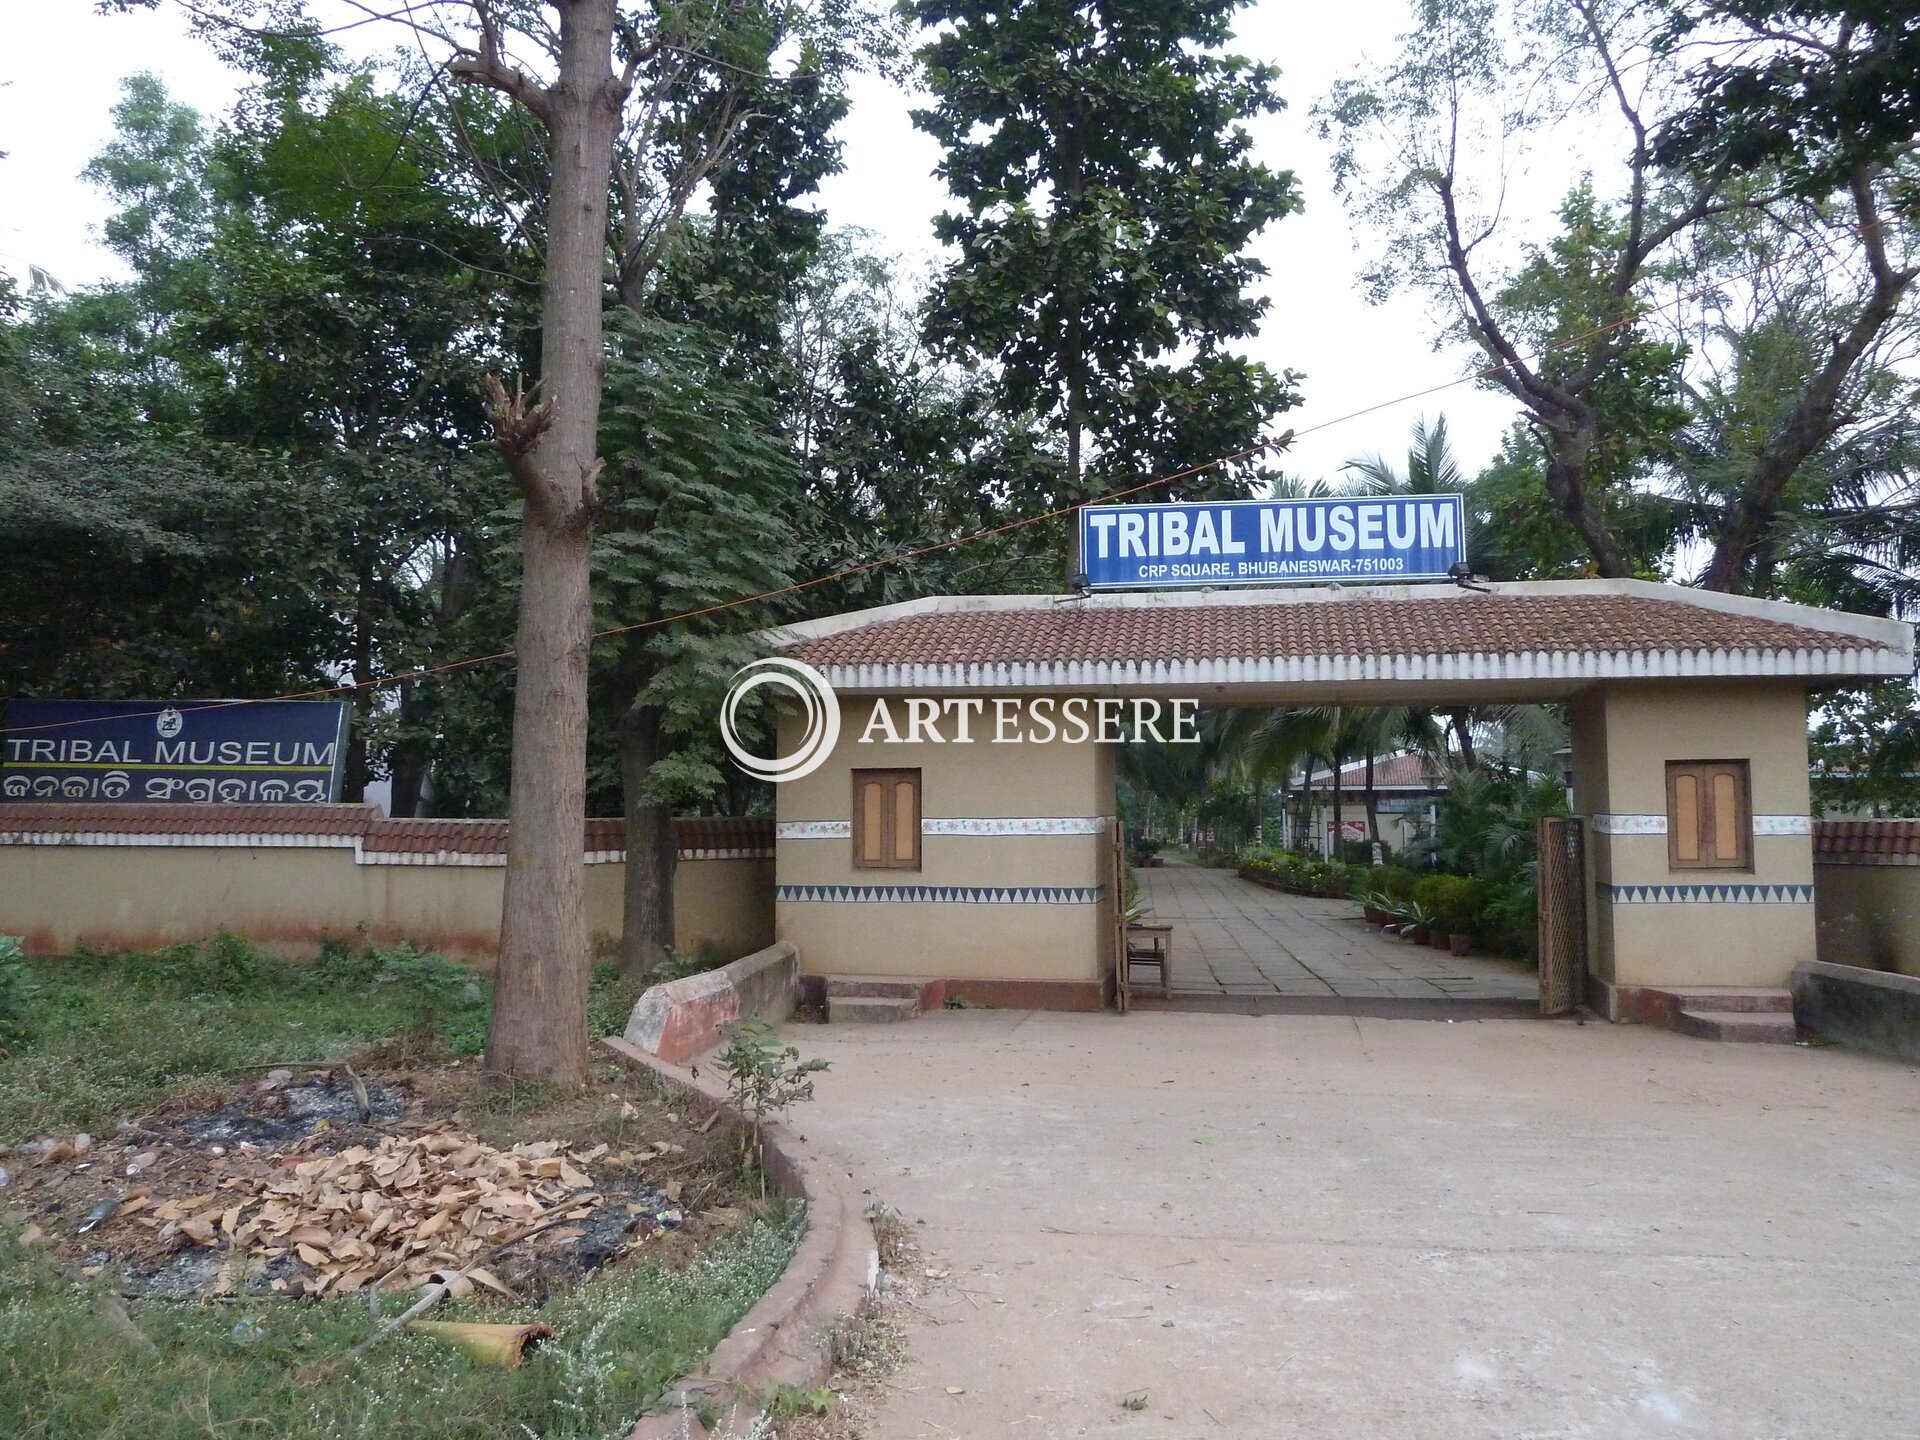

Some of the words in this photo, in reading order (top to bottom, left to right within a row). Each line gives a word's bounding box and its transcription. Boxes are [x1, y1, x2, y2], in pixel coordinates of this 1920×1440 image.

[1089, 509, 1246, 558] TRIBAL
[1259, 502, 1455, 553] MUSEUM
[1138, 564, 1168, 578] CRP
[1171, 562, 1234, 577] SQUARE,
[1237, 557, 1404, 576] BHUBANESWAR-751003
[6, 739, 142, 763] TRIBAL
[154, 741, 335, 765] MUSEUM
[3, 770, 131, 799] ଜନଜାତି
